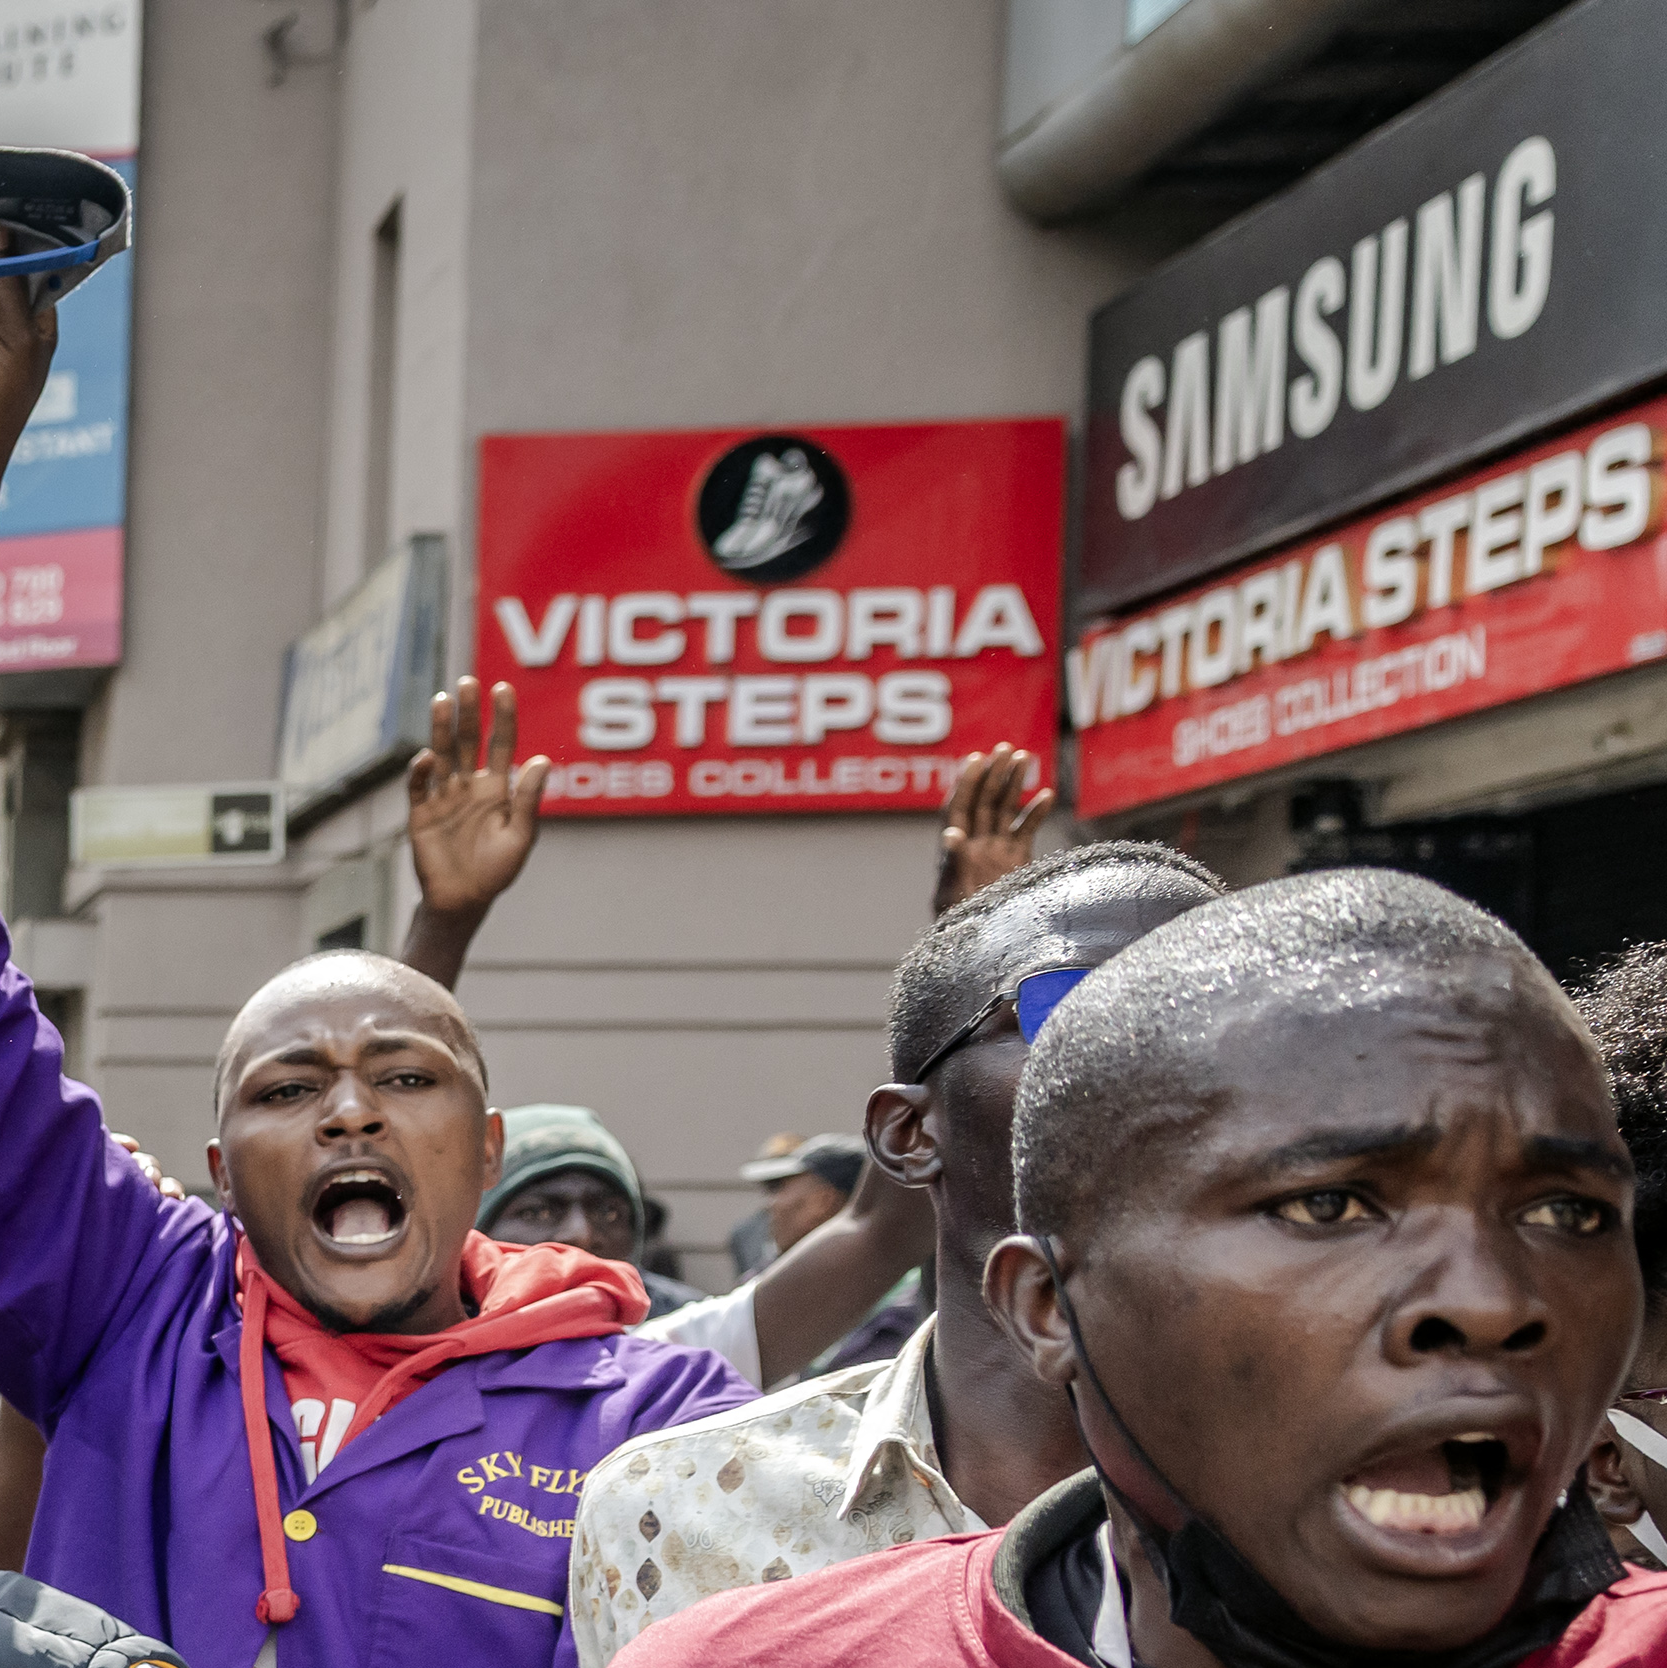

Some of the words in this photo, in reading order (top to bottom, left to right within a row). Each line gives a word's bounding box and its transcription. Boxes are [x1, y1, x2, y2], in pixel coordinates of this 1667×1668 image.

[1117, 135, 1557, 522] SAMSUNG
[1066, 543, 1354, 729] VICTORIA
[1362, 422, 1652, 630] STEPS
[494, 583, 1045, 667] VICTORIA
[578, 670, 952, 750] STEPS
[1173, 695, 1270, 767] SHOES
[1275, 624, 1487, 737] COLLECTION
[689, 755, 1042, 799] COLLECTI
[456, 1451, 524, 1494] SKY
[529, 1464, 588, 1498] FLY
[478, 1495, 576, 1538] PUBLISHE
